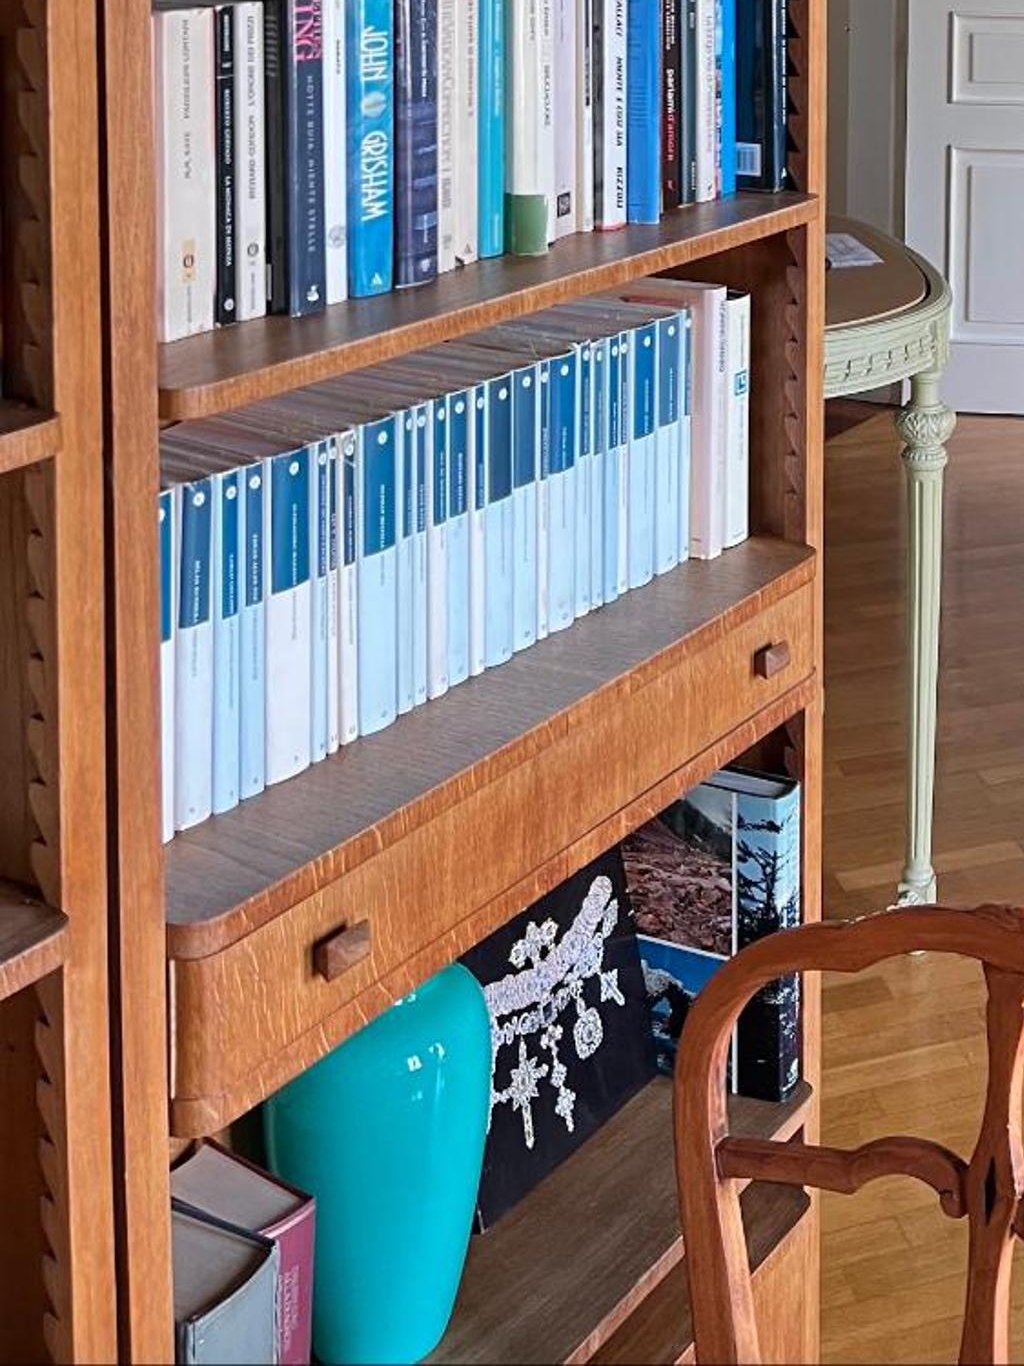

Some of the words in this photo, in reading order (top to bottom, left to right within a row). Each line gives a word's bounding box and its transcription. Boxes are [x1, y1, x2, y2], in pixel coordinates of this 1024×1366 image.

[247, 15, 255, 45] PRIZZI
[361, 25, 389, 81] JOHN
[306, 75, 314, 115] NOTTE
[615, 56, 623, 93] NIENTE
[666, 68, 675, 114] parlami
[223, 88, 231, 126] ROBERTO
[667, 114, 675, 161] d'amore
[225, 175, 232, 186] LA
[307, 159, 316, 203] NIENTE
[361, 131, 389, 222] GRISHAM
[616, 166, 624, 209] RIZZOLI
[225, 224, 233, 235] DI
[308, 209, 316, 252] STELLE
[225, 236, 233, 266] MONZA
